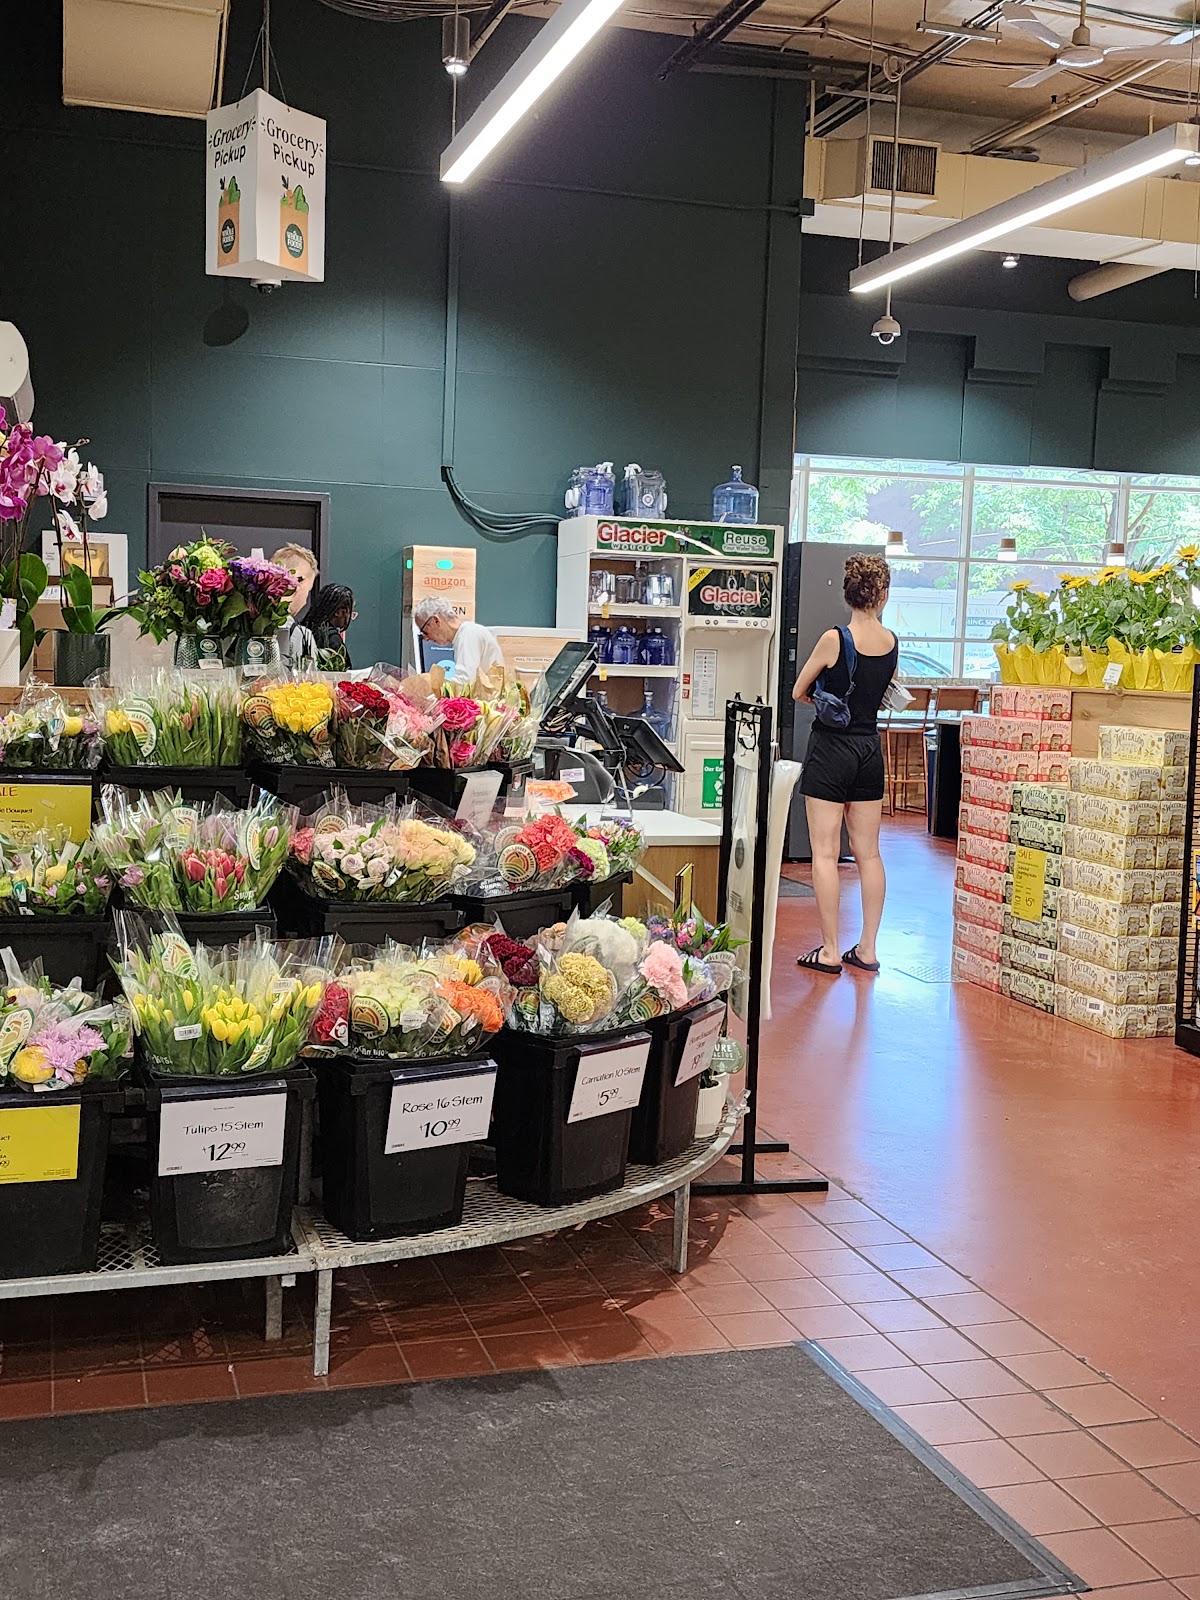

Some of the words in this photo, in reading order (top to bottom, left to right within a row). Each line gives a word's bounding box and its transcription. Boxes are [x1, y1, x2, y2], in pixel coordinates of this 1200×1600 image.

[213, 120, 251, 148] Grocery
[266, 118, 318, 158] Grocery
[214, 144, 246, 169] Pickup
[273, 142, 315, 178] Pickup
[286, 231, 303, 241] WHOLE
[287, 239, 303, 249] FOODS
[598, 523, 667, 545] Glacier
[726, 532, 766, 545] Reuse
[612, 543, 652, 551] Water
[424, 576, 466, 588] amazon
[1114, 728, 1145, 748] WATERLOO
[1082, 764, 1111, 780] WATERLOO
[1080, 798, 1109, 815] WATERLOO
[1077, 831, 1106, 849] WATERLOO
[1018, 849, 1033, 860] SALE
[1075, 863, 1104, 883] WATERLOO
[1072, 895, 1100, 915] WATERLOO
[1078, 930, 1099, 948] ATERLOO
[1069, 996, 1088, 1012] WATER
[581, 1071, 615, 1086] Carnation
[614, 1068, 624, 1078] 10
[623, 1066, 641, 1076] Stem
[402, 1102, 434, 1114] Rose
[436, 1097, 450, 1109] 16
[452, 1095, 483, 1107] Stem
[183, 1125, 218, 1135] Tulips
[220, 1122, 233, 1132] 15
[234, 1121, 264, 1130] Stem
